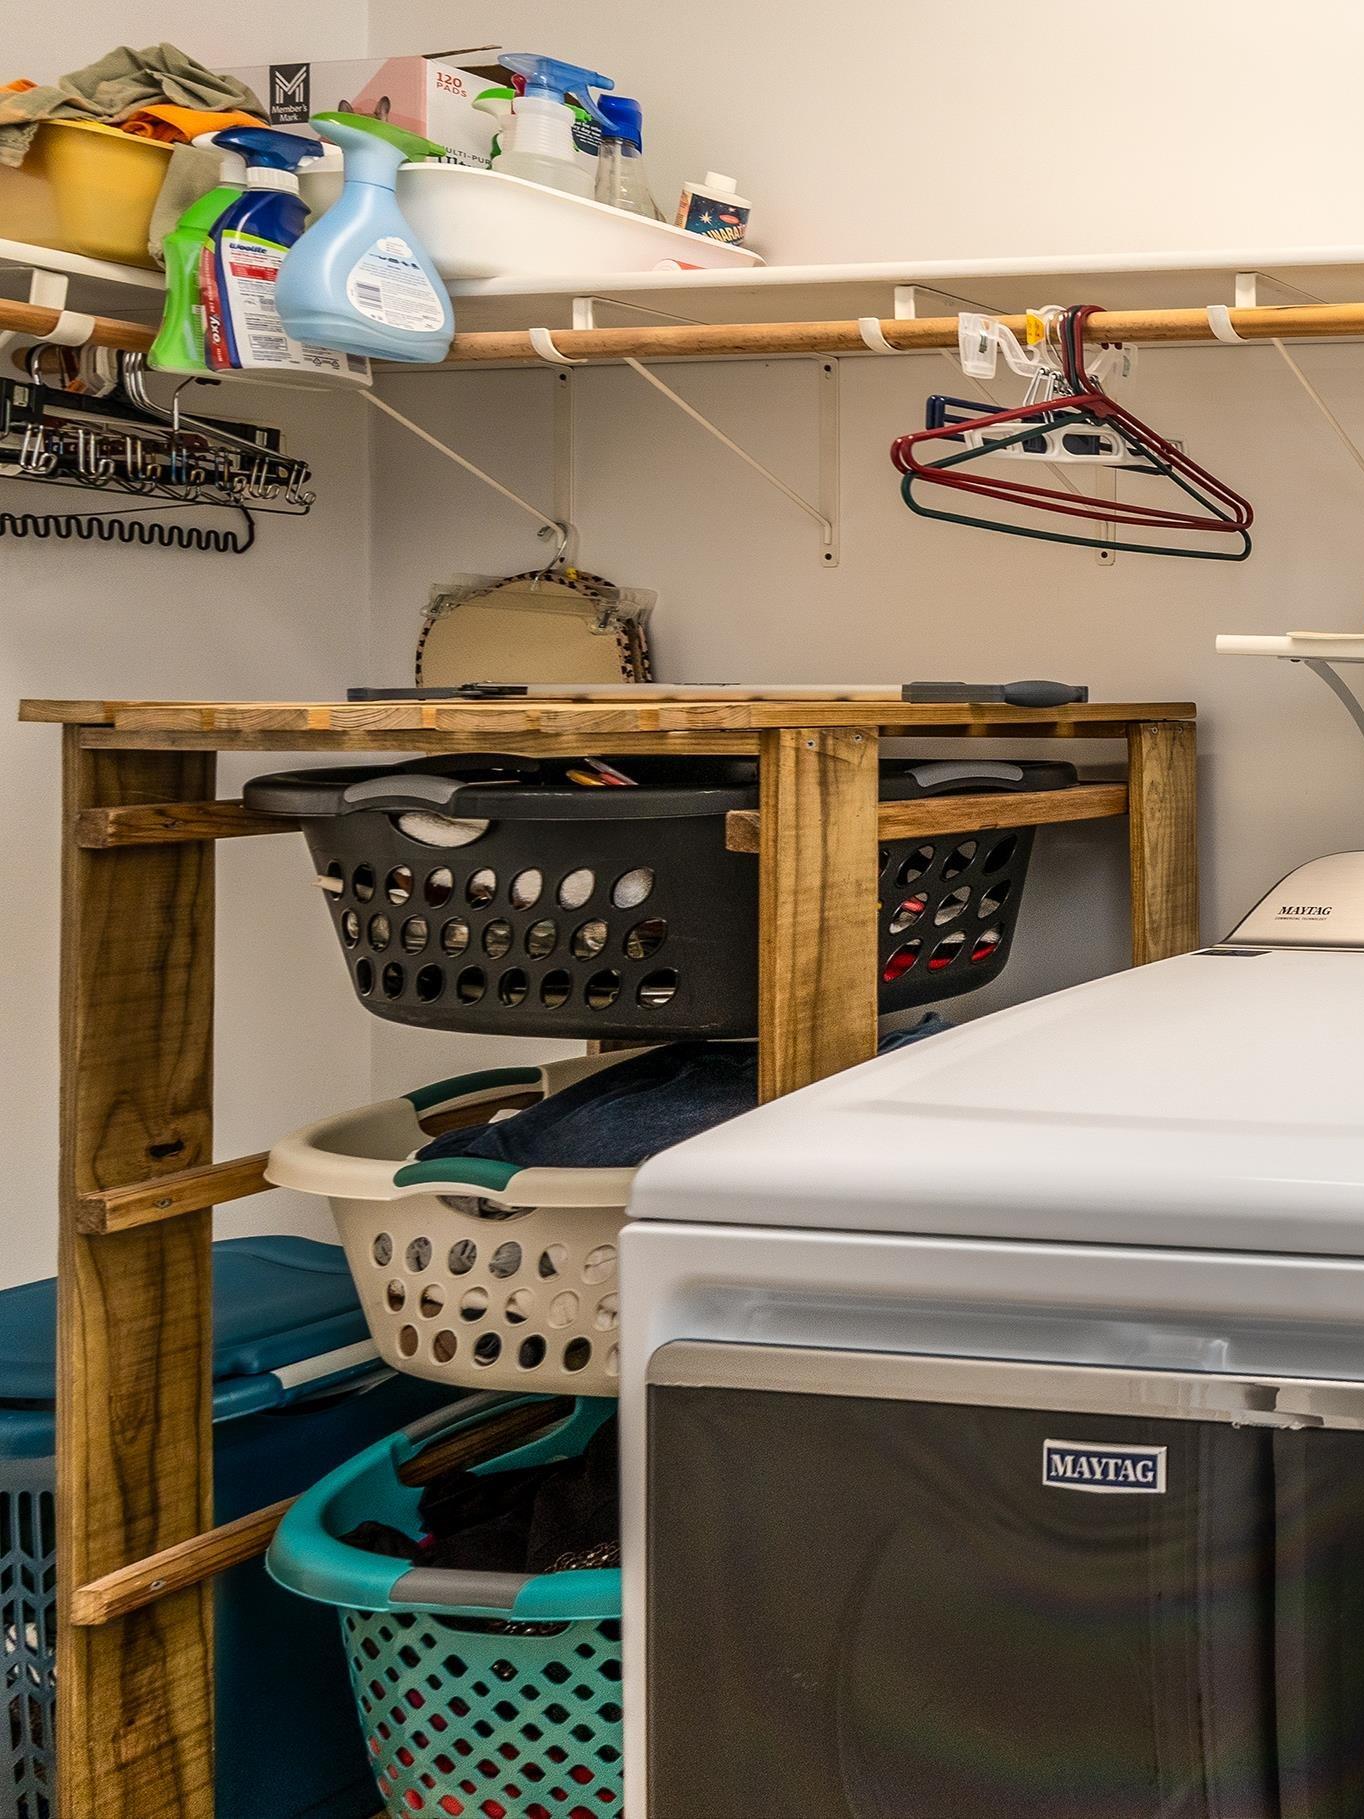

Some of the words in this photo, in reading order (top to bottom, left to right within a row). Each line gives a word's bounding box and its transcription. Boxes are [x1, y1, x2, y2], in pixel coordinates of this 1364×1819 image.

[437, 72, 462, 87] 120
[437, 81, 467, 97] PADS
[272, 104, 308, 114] Member's
[209, 316, 221, 343] oxy
[1277, 906, 1333, 915] MAYTAG
[1050, 1454, 1155, 1483] MAYTAG
